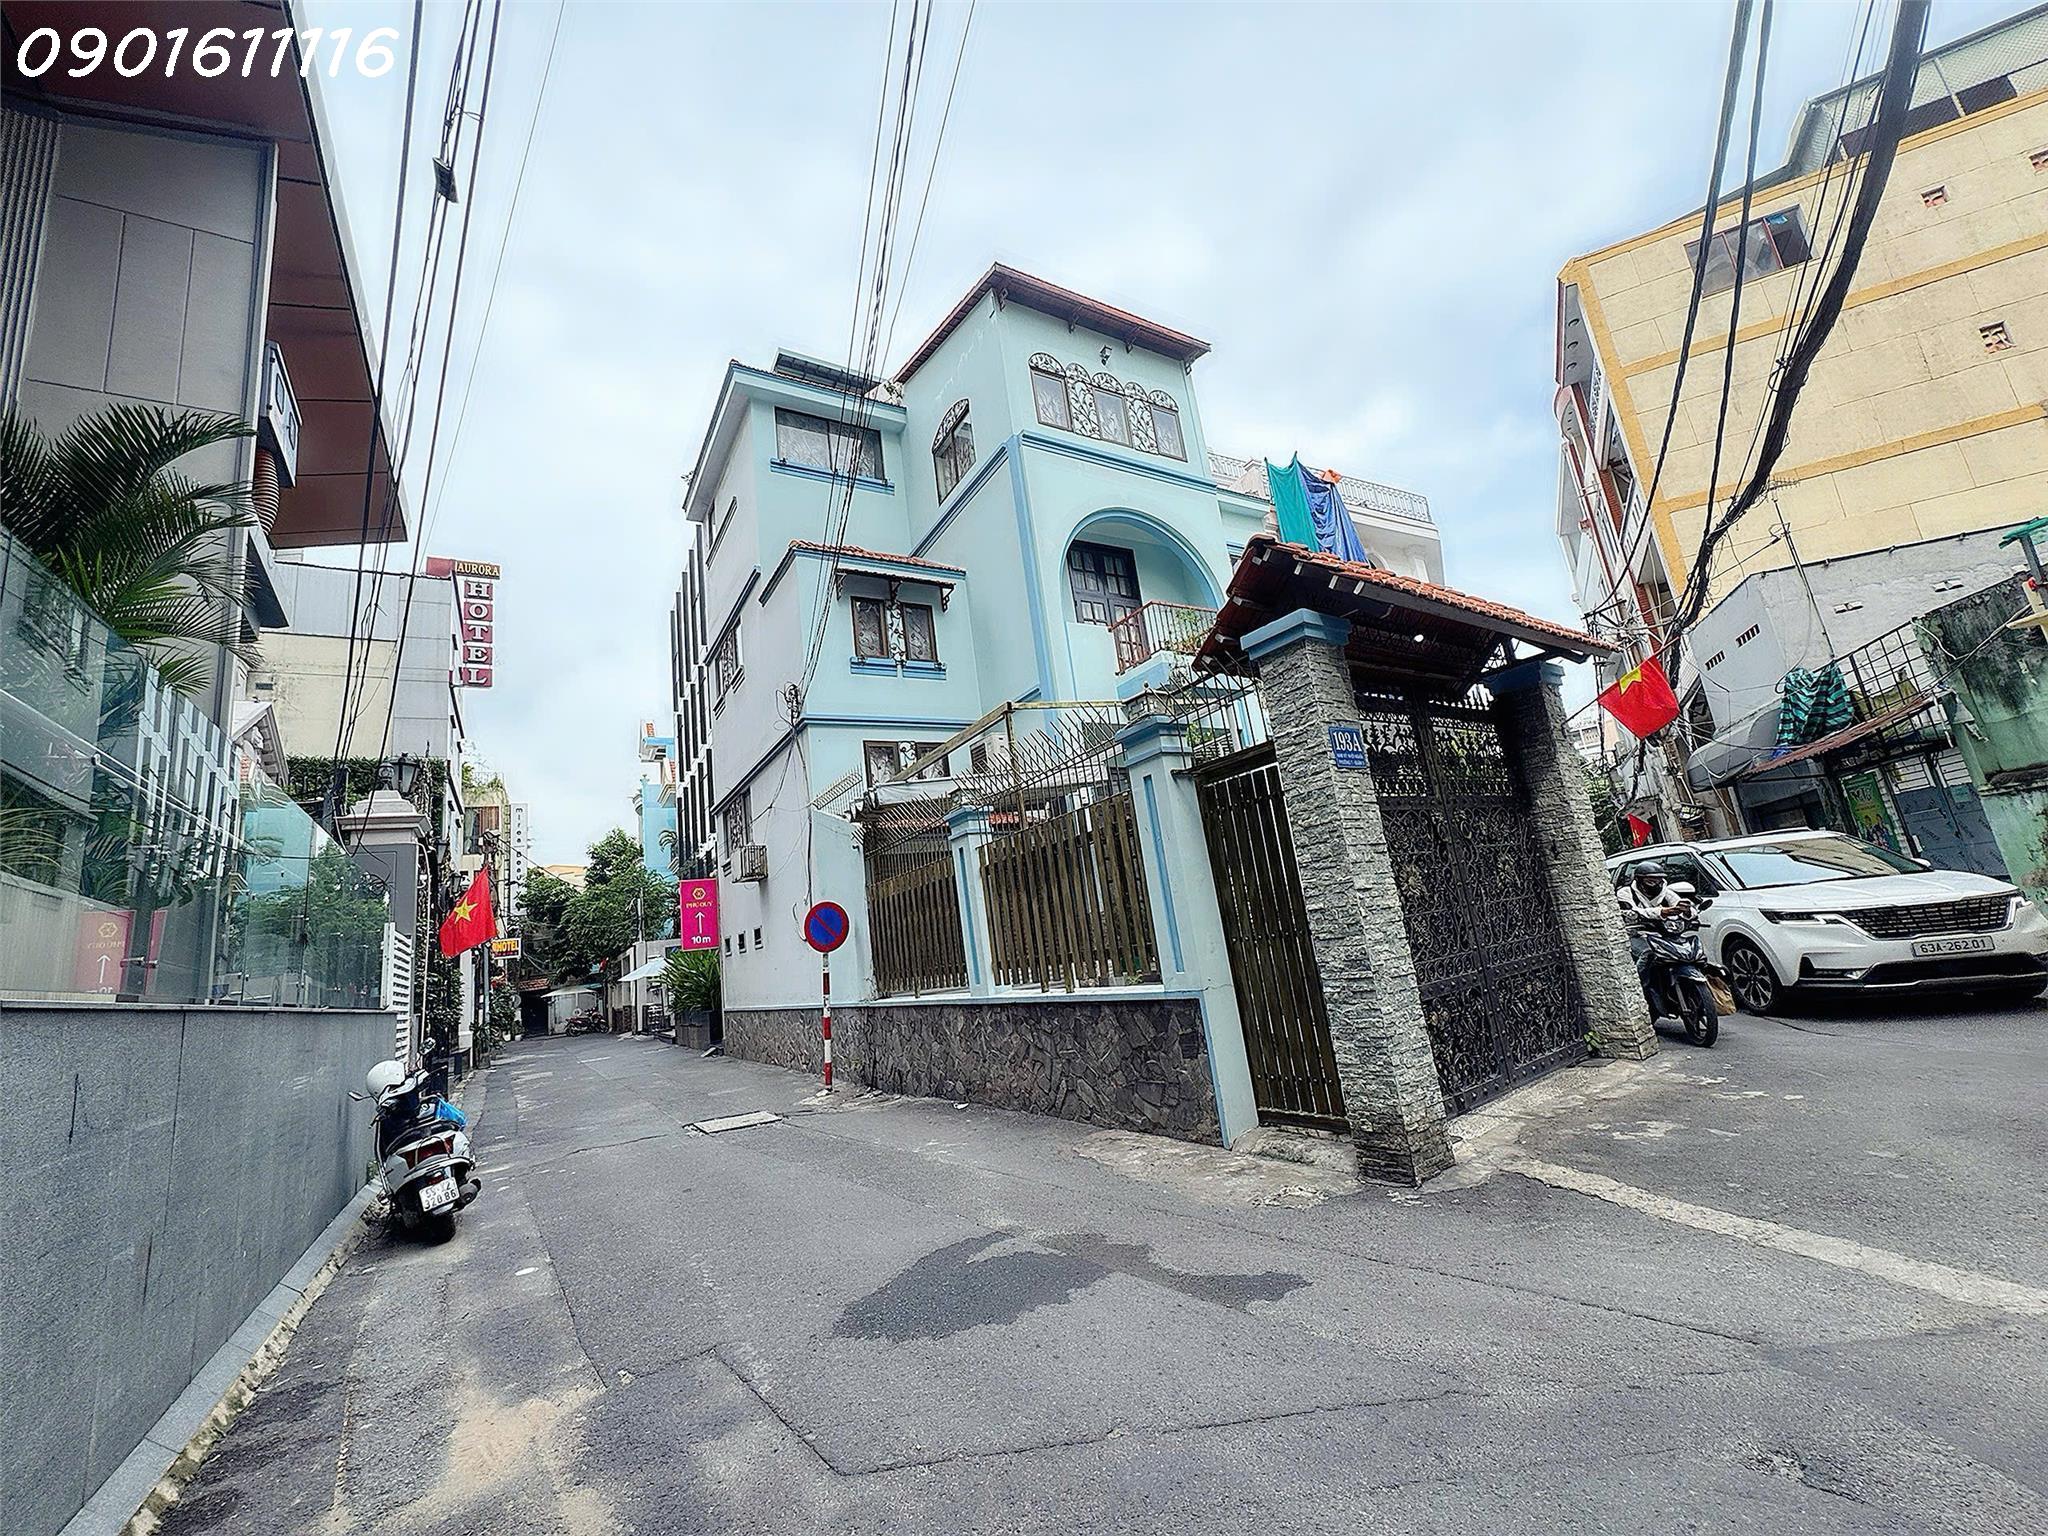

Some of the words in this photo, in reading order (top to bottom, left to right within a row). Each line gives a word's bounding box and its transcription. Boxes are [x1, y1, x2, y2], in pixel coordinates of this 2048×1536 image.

[457, 563, 499, 576] AURORA
[467, 581, 490, 684] HOTEL
[1333, 732, 1362, 751] 193A
[1920, 940, 1986, 953] 63A-262.01
